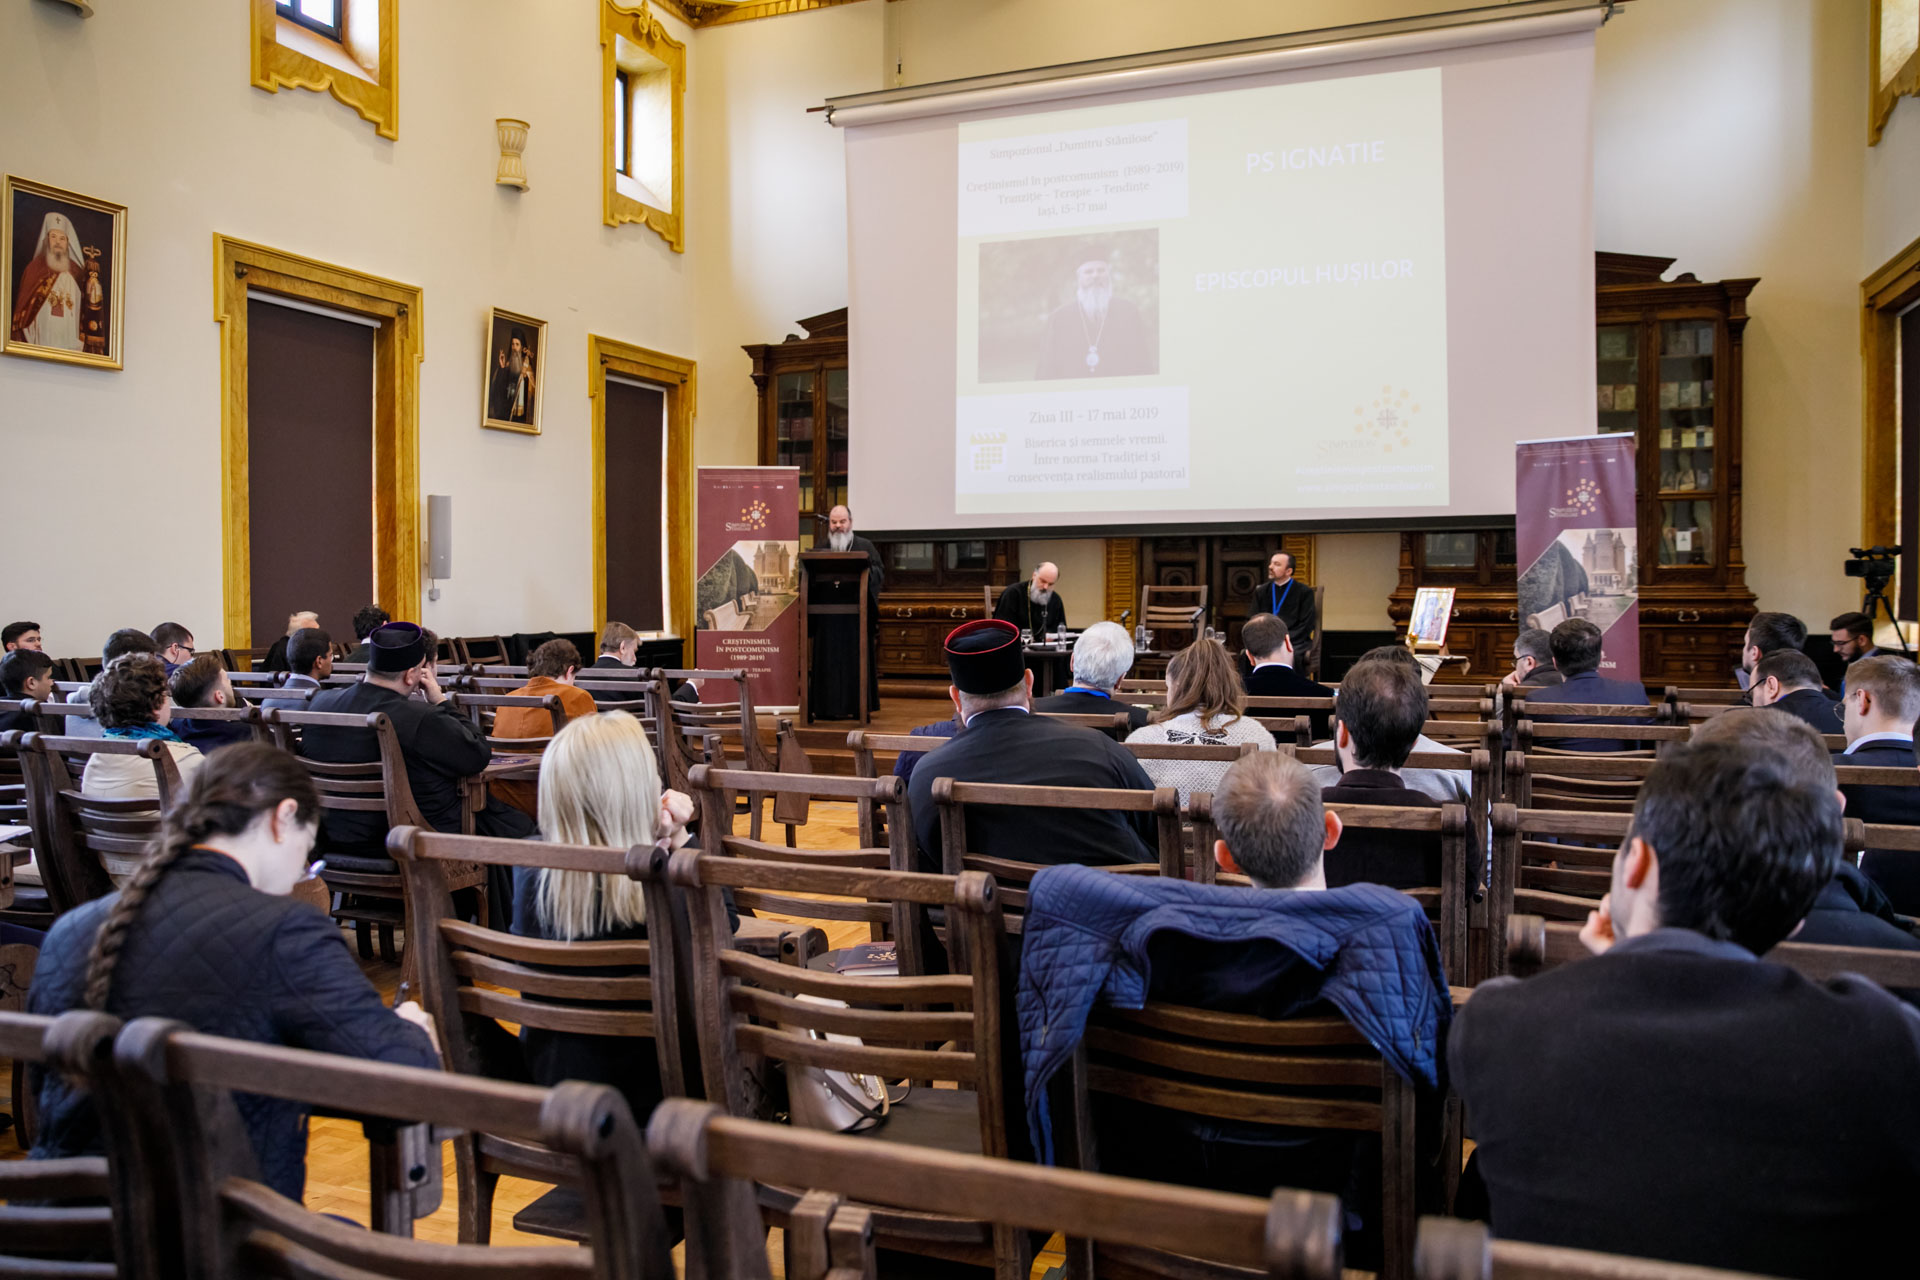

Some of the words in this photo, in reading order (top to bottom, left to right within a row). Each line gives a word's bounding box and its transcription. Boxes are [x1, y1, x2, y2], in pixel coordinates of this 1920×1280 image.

[989, 142, 1053, 160] Simpozionul
[1246, 150, 1275, 174] PS
[1281, 140, 1385, 170] IGNATIE
[1043, 168, 1119, 187] postcomunism
[1053, 188, 1092, 202] Terapie
[1088, 201, 1108, 212] mai
[1195, 266, 1311, 292] EPISCOPUL
[1315, 258, 1414, 287] HUȘILOR
[1029, 410, 1057, 424] Ziua
[1060, 410, 1074, 423] III
[1087, 408, 1100, 422] 17
[1102, 407, 1127, 421] mai
[1129, 407, 1159, 420] 2019
[1024, 437, 1067, 449] Biserica
[1080, 435, 1127, 448] semnele
[1062, 455, 1099, 465] norma
[1076, 469, 1138, 481] realismului
[1140, 466, 1186, 483] pastoral
